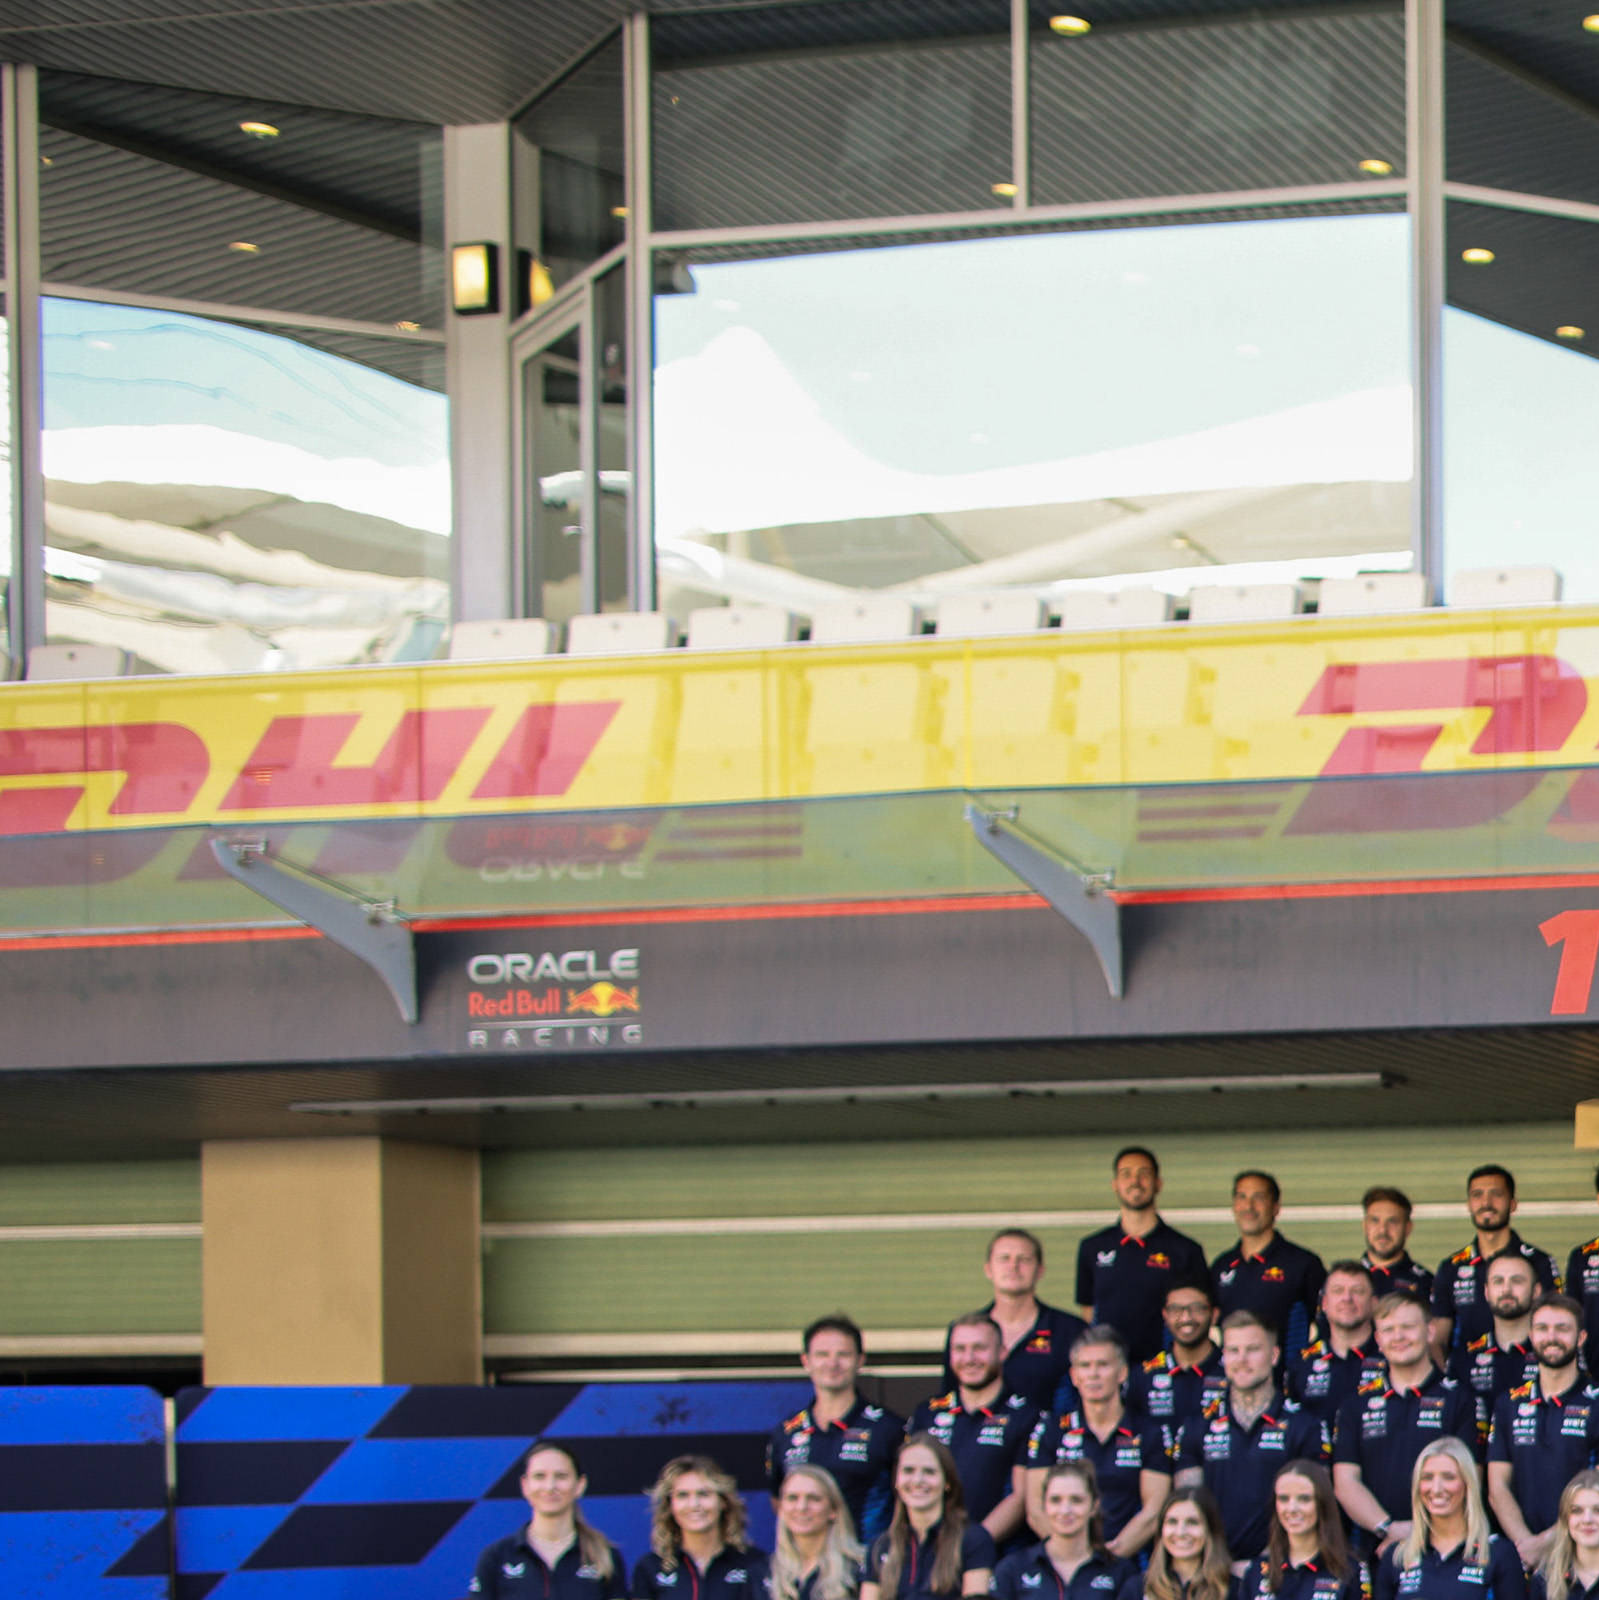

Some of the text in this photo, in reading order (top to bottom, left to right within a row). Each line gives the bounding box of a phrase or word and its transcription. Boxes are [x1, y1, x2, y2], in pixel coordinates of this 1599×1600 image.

[467, 949, 640, 984] ORACLE
[468, 987, 561, 1016] Red Bull
[468, 1024, 642, 1048] RACING
